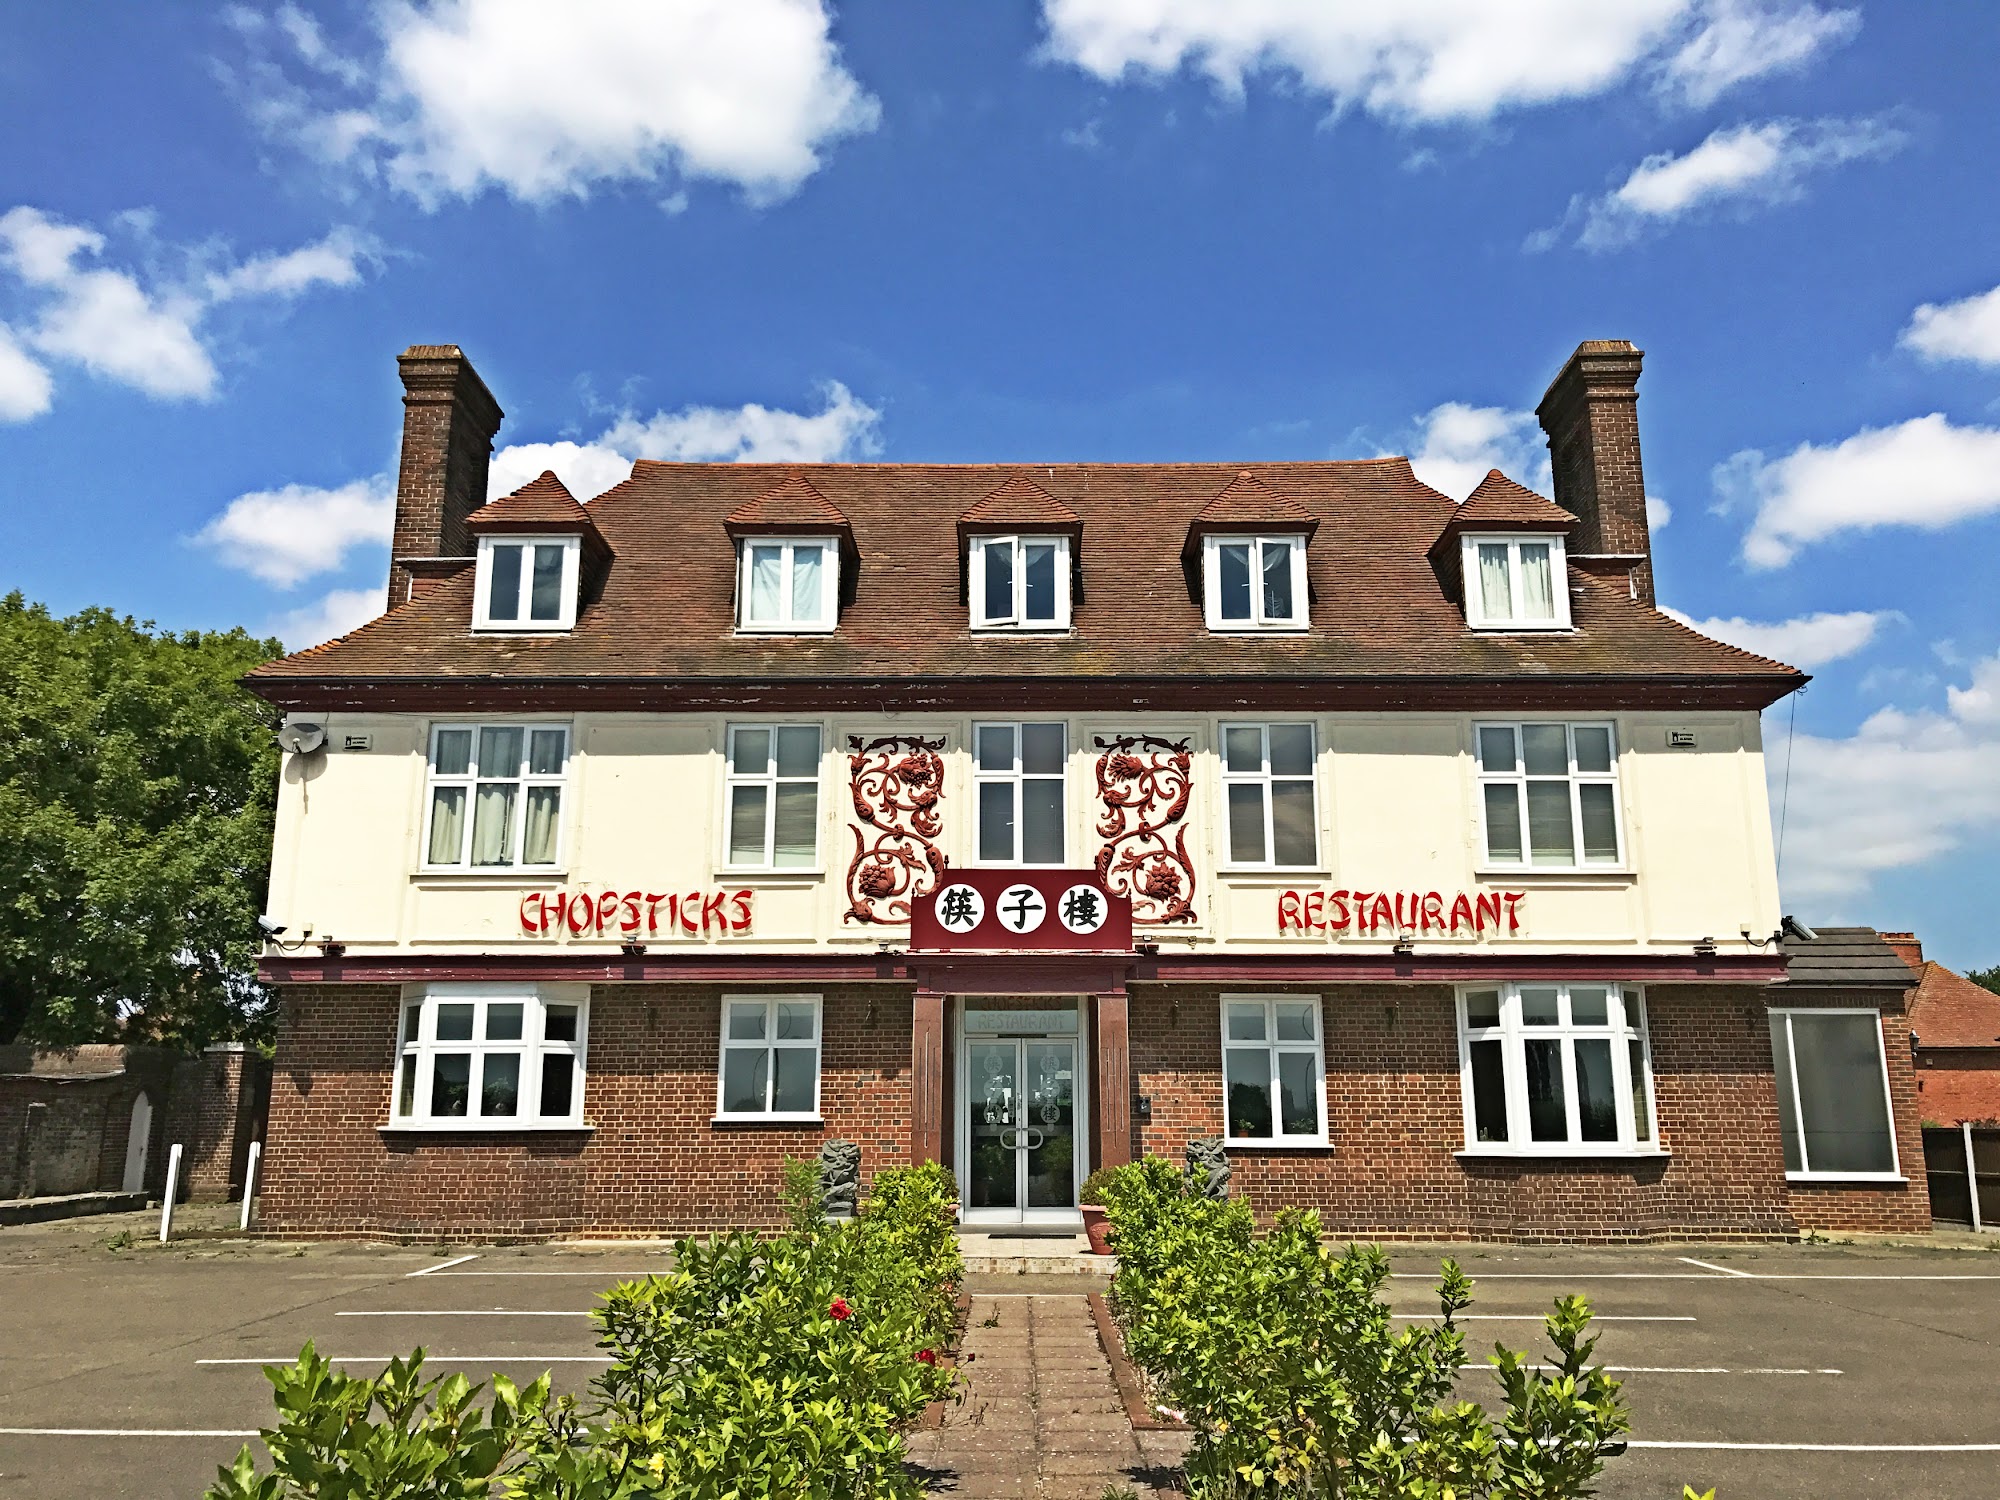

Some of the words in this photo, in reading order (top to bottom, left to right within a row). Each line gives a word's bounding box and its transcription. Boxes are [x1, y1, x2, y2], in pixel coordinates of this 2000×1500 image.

[520, 890, 753, 932] CHOPSTICKS
[941, 887, 1100, 930] 筷子樓
[1278, 890, 1526, 932] RESTAURANT
[978, 1014, 1066, 1030] RESTAURANT
